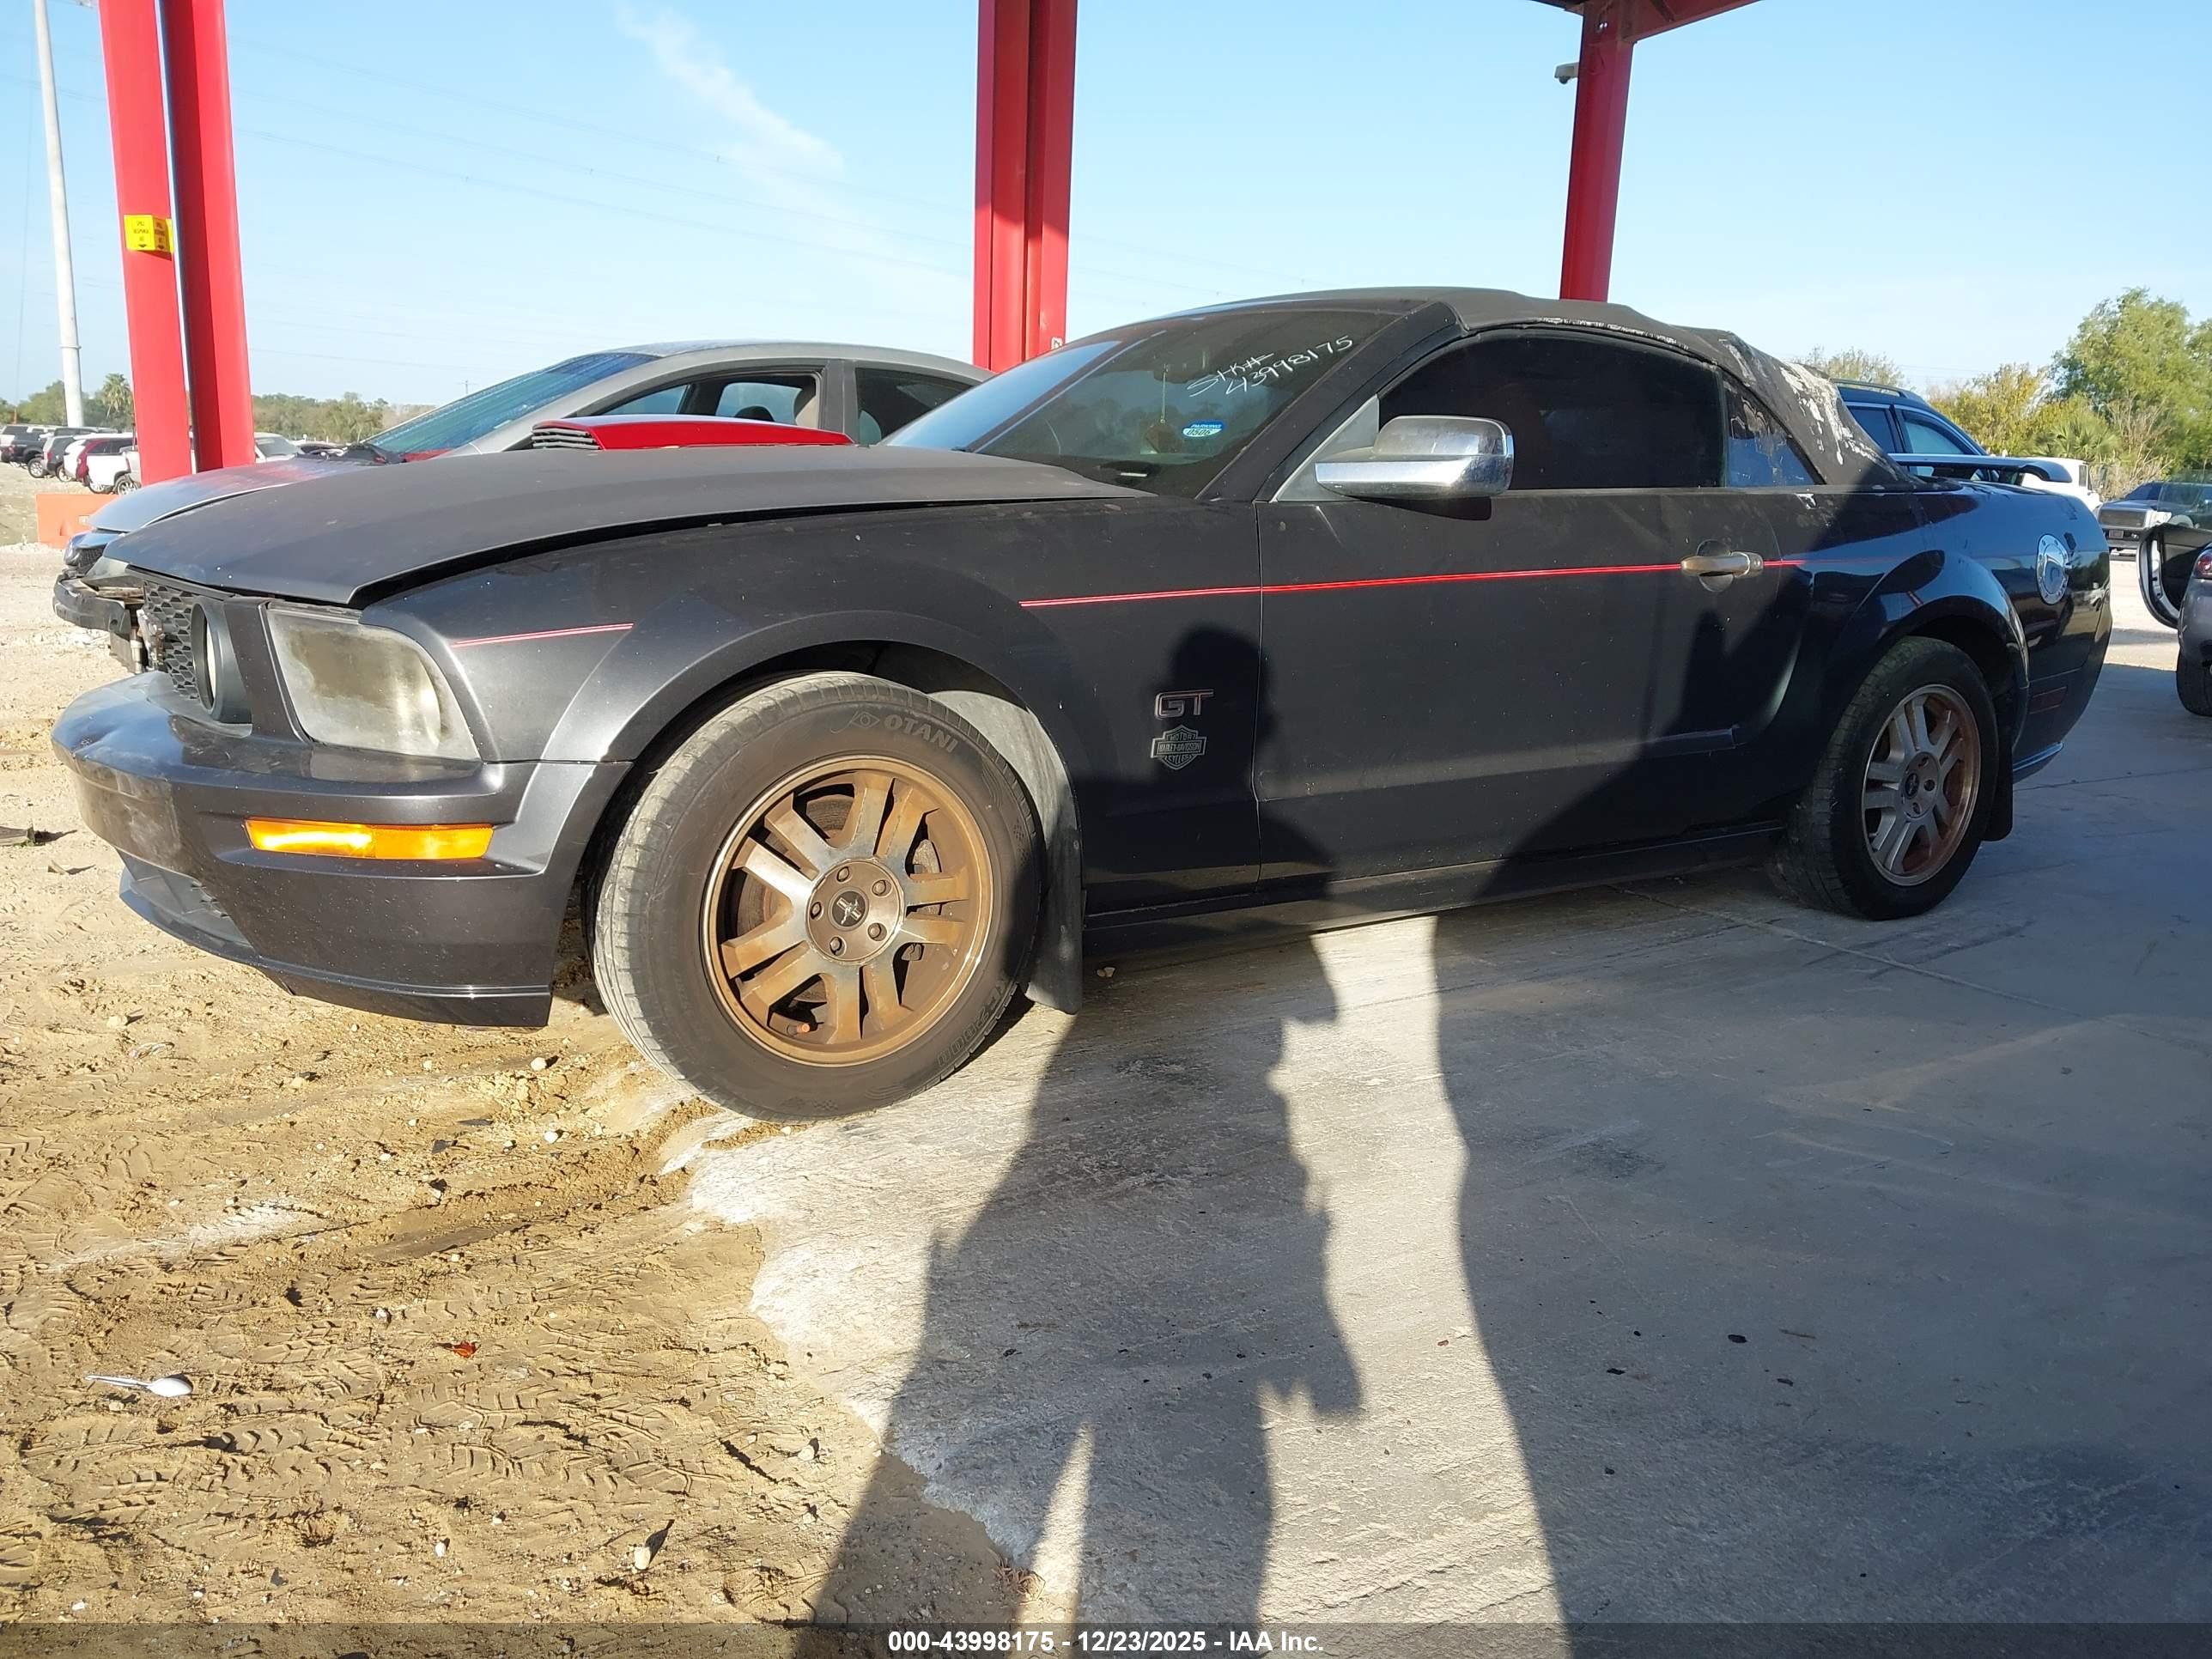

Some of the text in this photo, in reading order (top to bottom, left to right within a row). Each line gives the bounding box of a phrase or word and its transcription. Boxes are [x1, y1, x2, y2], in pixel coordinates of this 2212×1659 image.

[1225, 335, 1353, 395] 43998175
[1154, 689, 1214, 720] GT
[884, 714, 958, 753] OTANI
